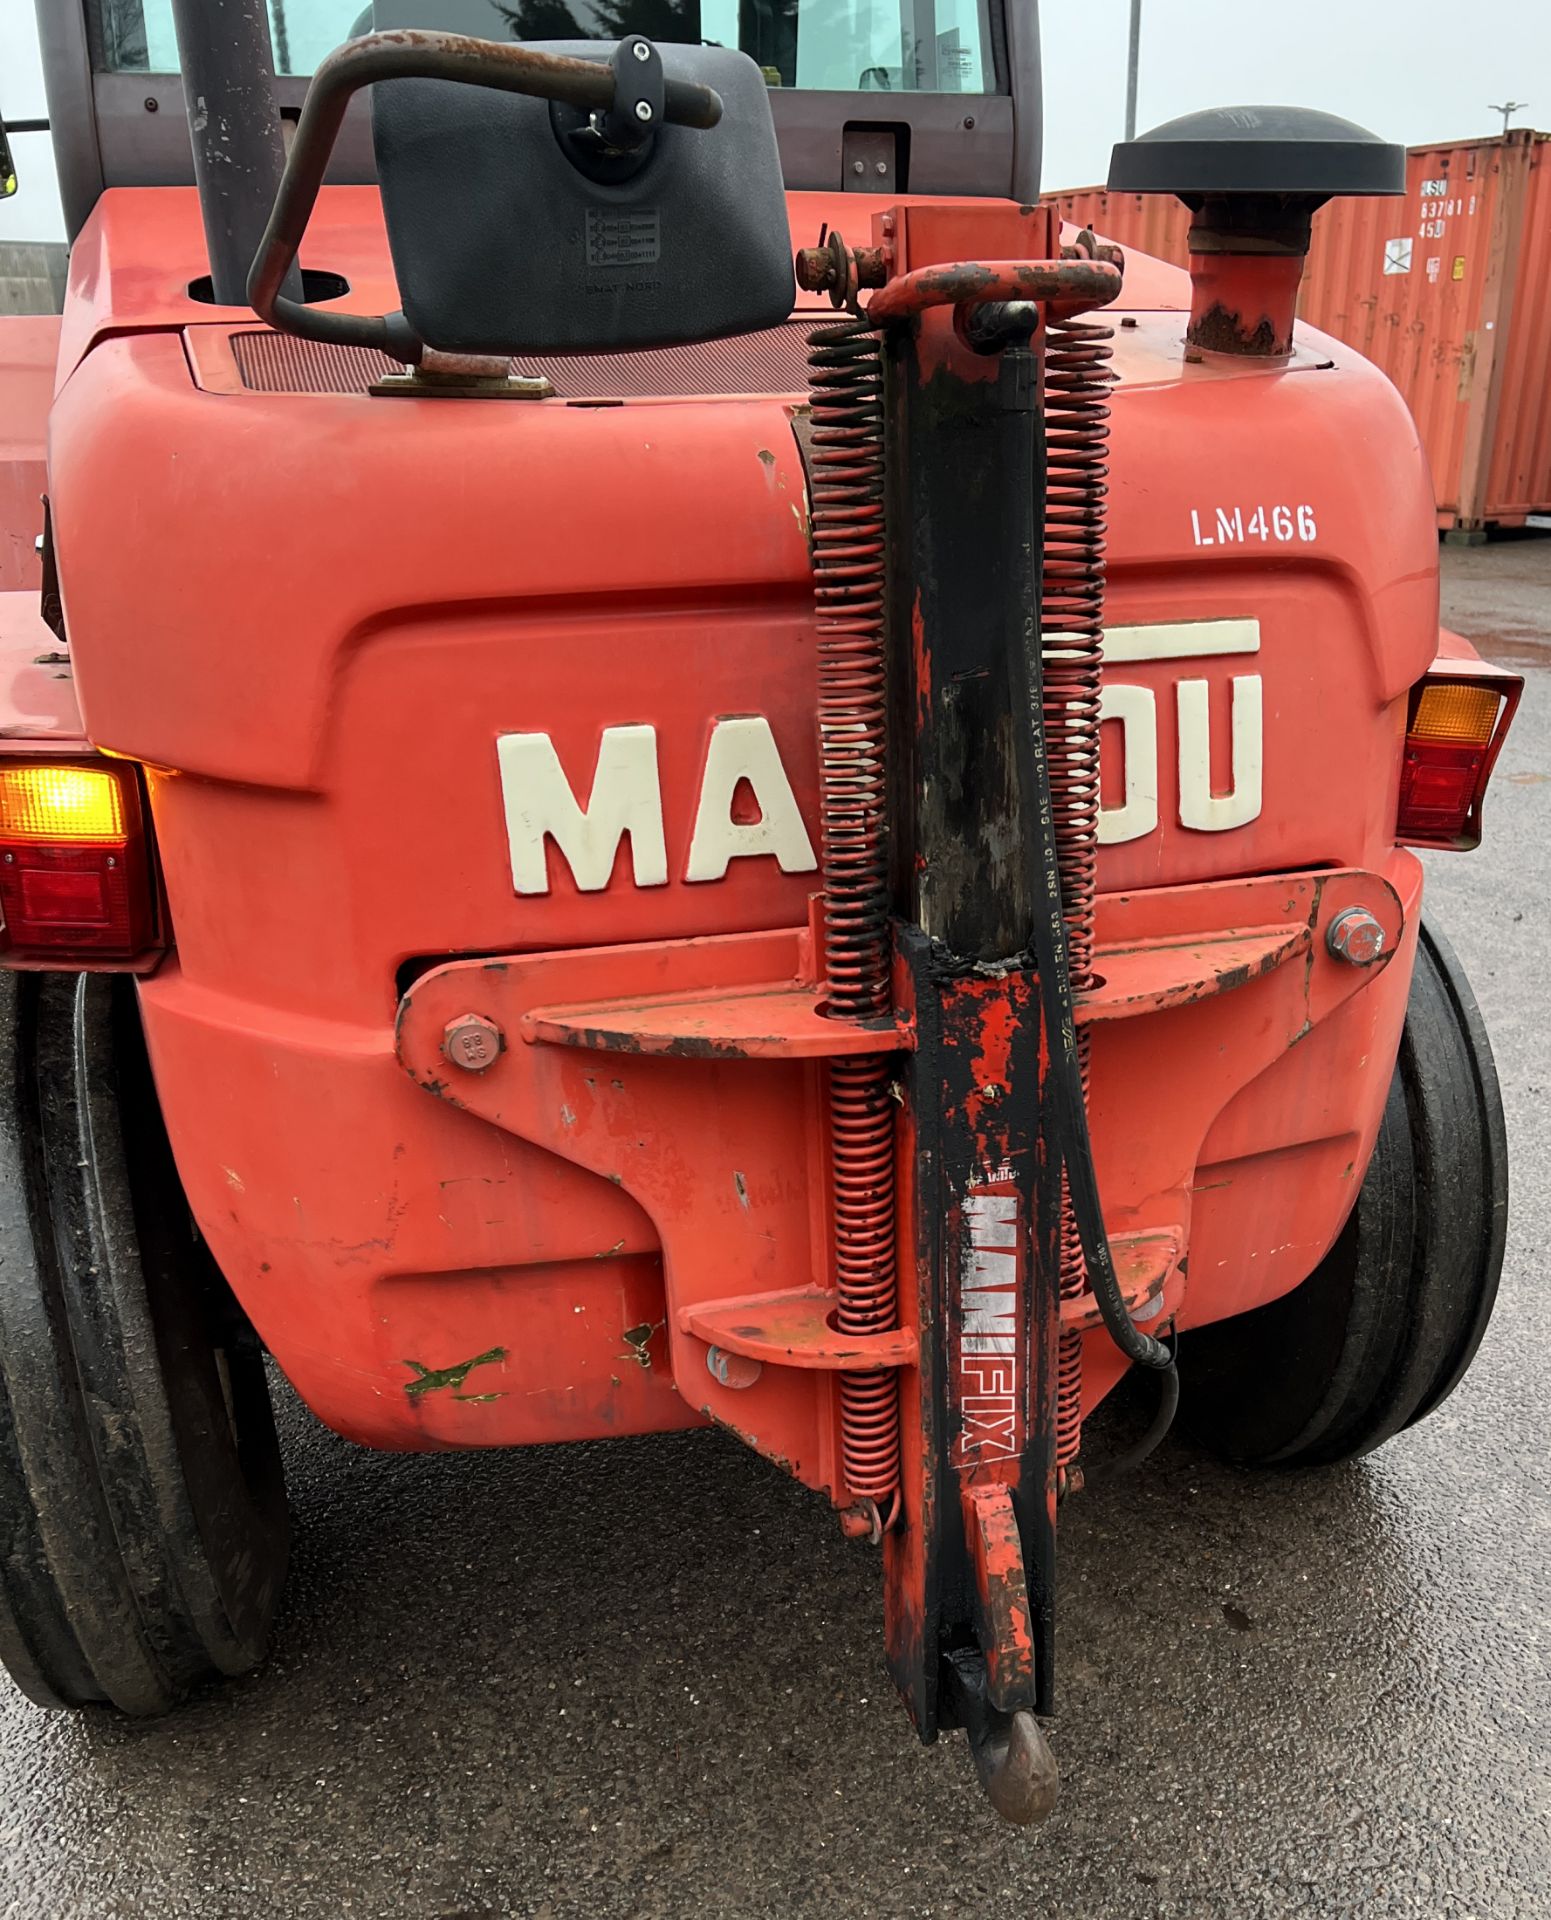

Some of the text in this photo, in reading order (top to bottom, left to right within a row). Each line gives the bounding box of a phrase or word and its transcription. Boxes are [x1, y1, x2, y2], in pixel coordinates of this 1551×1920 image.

[1191, 505, 1318, 545] LM466
[1039, 796, 1050, 824] SAE
[960, 1195, 1018, 1453] MANIFIX
